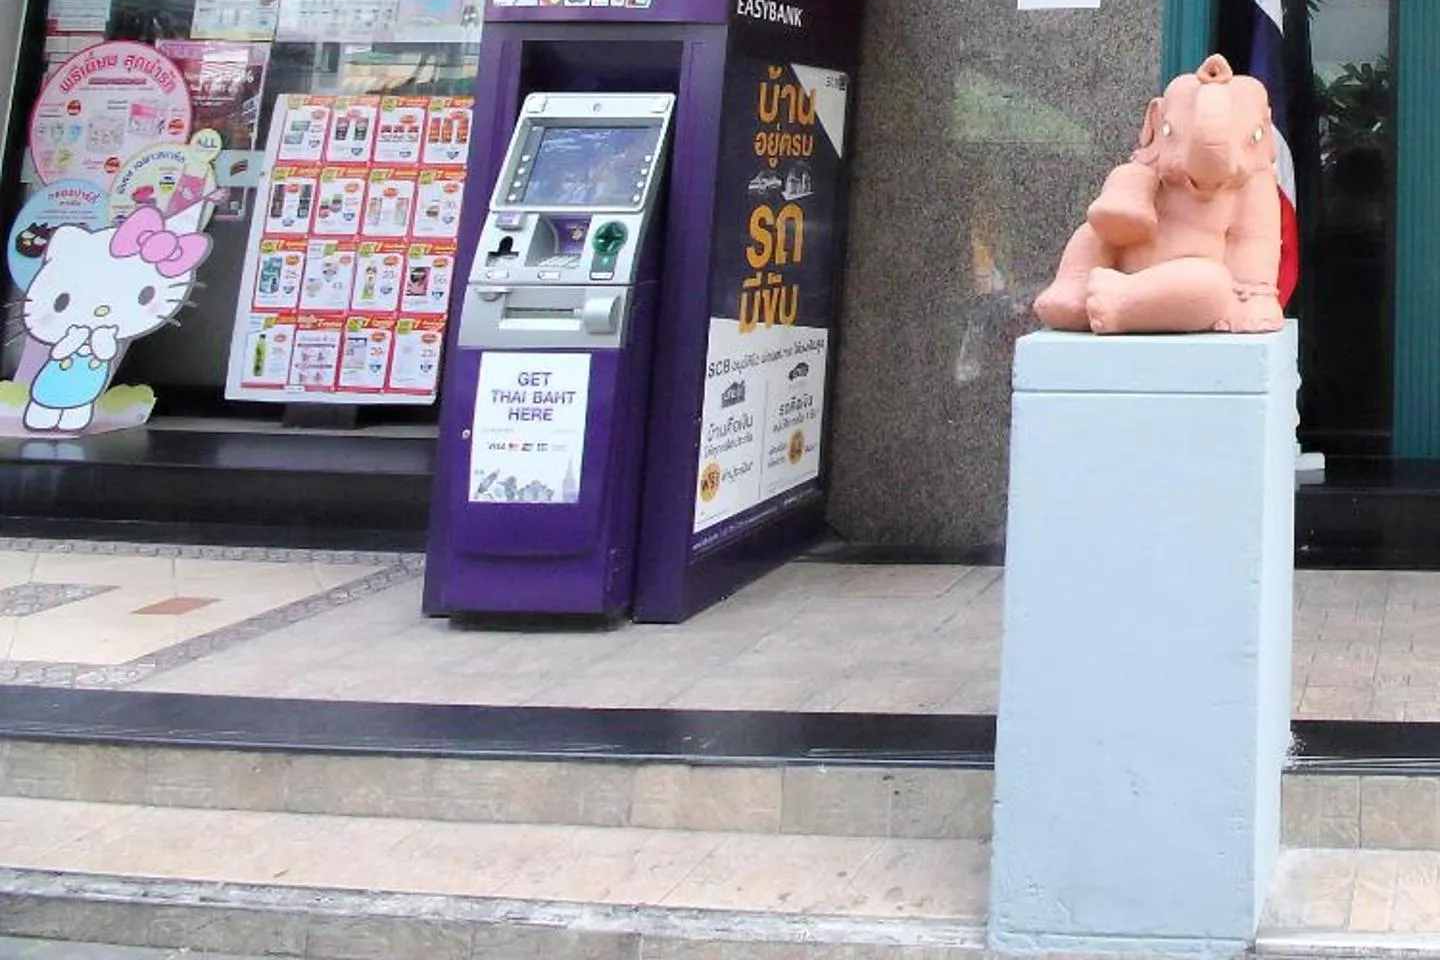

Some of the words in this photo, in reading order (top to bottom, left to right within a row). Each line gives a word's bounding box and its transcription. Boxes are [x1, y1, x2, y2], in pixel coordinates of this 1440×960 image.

[758, 64, 817, 126] บ้าน
[708, 359, 730, 378] SCB
[517, 371, 552, 387] GET
[491, 390, 526, 404] THAI
[532, 391, 576, 405] BAHT
[508, 407, 554, 422] HERE
